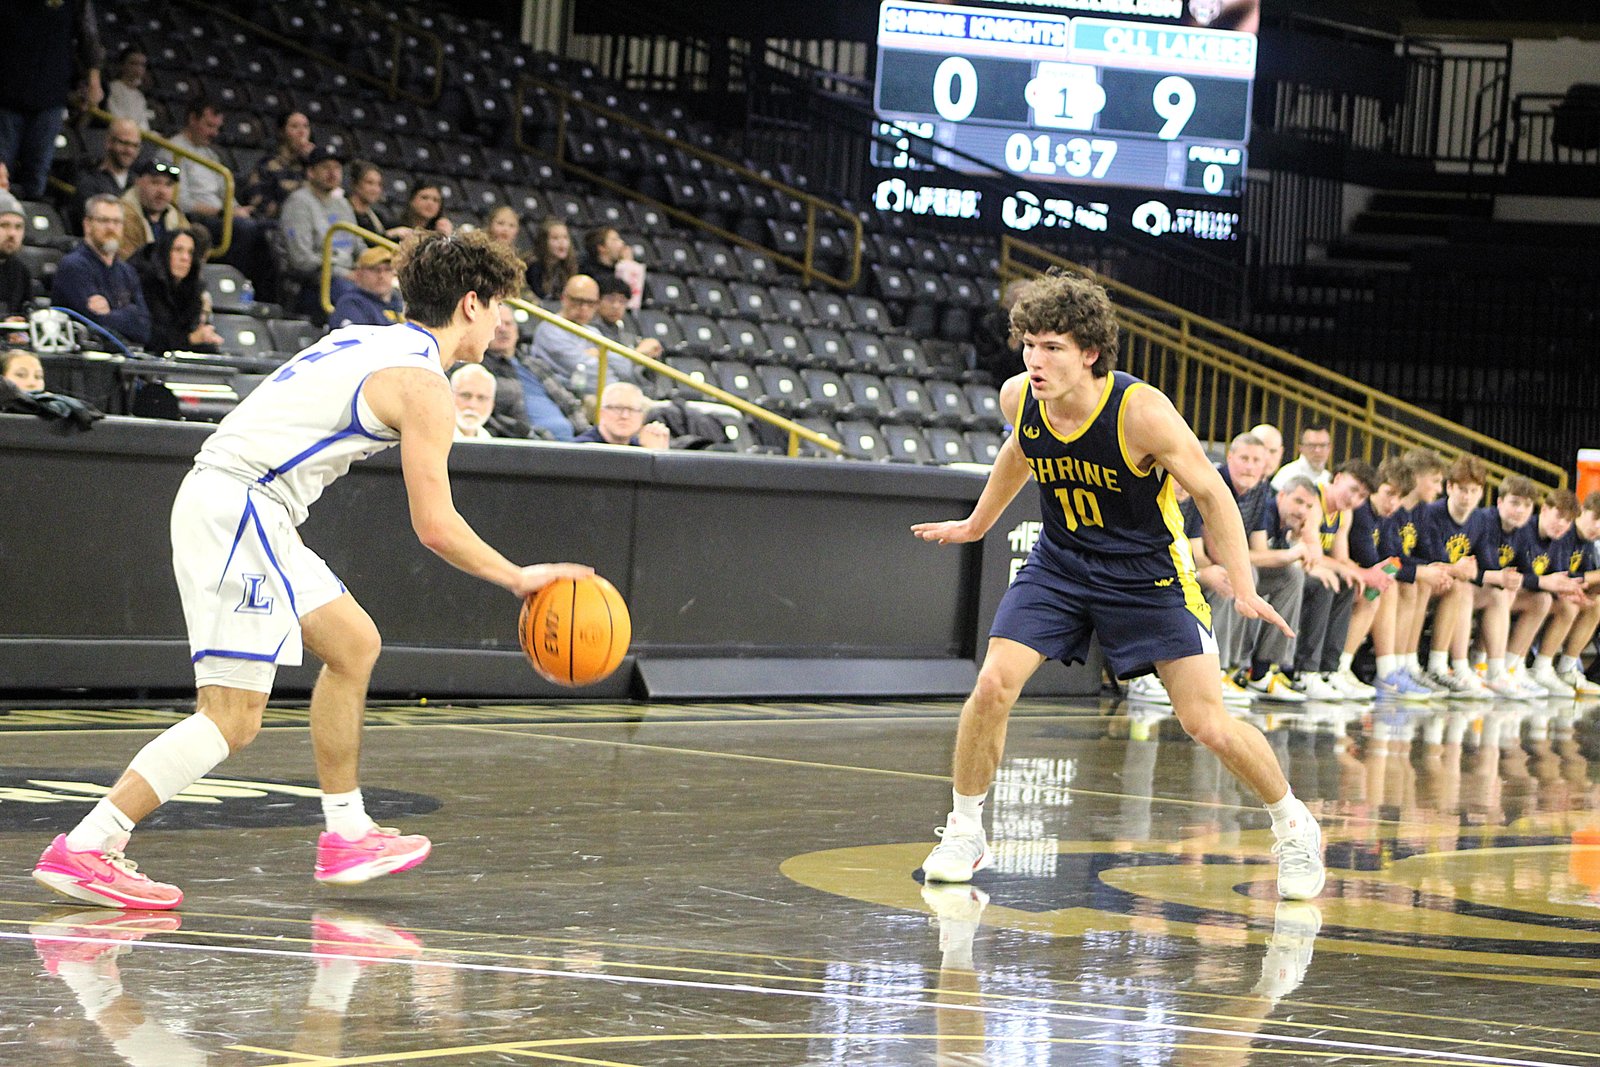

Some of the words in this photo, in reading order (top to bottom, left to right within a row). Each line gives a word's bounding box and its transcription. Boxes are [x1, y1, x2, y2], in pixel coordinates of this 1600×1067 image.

[886, 8, 966, 38] SHRINE
[969, 16, 1065, 47] KNIGHTS
[1103, 27, 1153, 54] OLL
[1156, 32, 1251, 64] LAKERS
[932, 56, 979, 122] 0
[1054, 87, 1074, 119] 1
[1152, 75, 1197, 141] 9
[1004, 132, 1118, 179] 01:37
[1202, 163, 1225, 195] 0
[1025, 456, 1122, 493] SHRINE
[1054, 488, 1104, 533] 10
[234, 573, 274, 615] L
